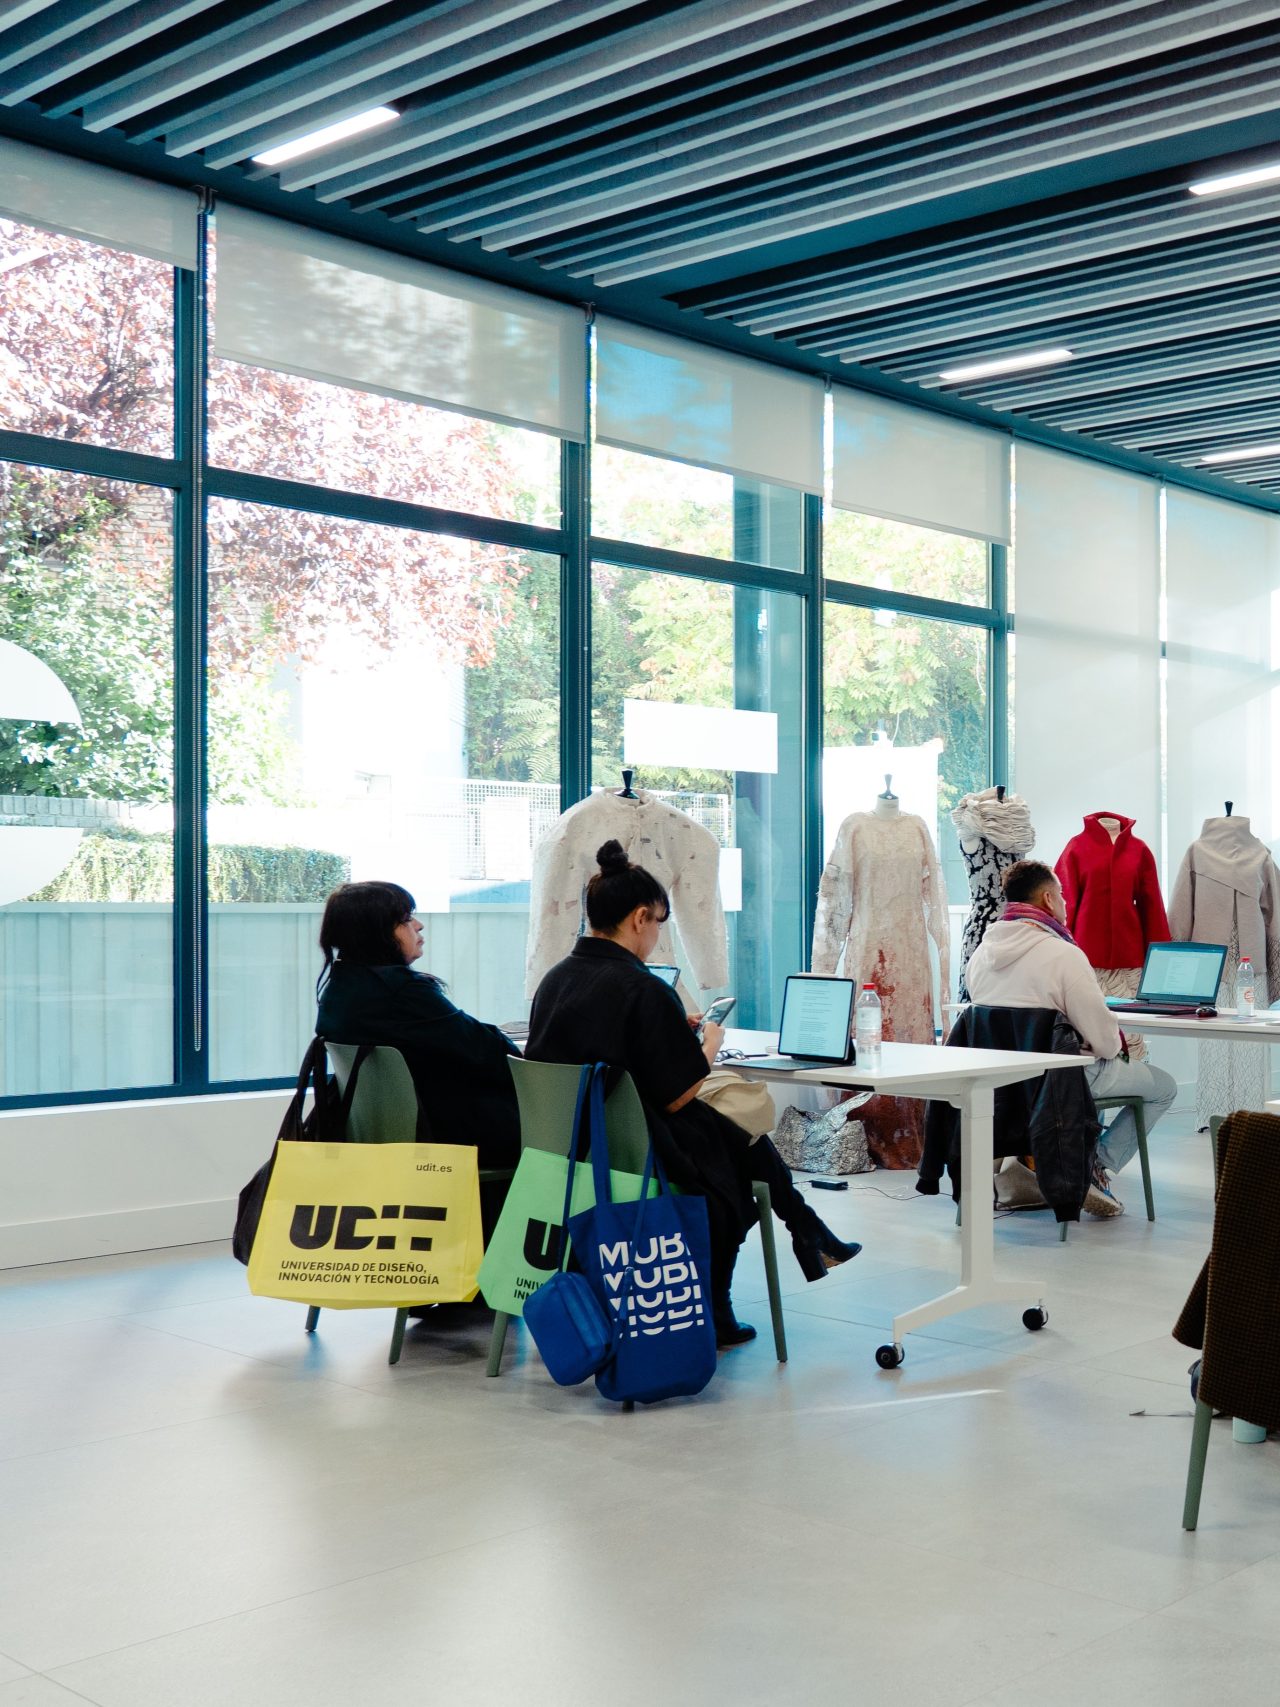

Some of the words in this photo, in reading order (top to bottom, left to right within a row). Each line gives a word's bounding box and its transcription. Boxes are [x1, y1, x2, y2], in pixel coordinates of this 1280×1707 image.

[416, 1163, 453, 1173] udit.es
[289, 1204, 448, 1251] UDIT
[281, 1260, 359, 1272] UNIVERSIDAD
[362, 1262, 376, 1272] DE
[378, 1261, 427, 1274] DISEÑO,
[278, 1271, 351, 1283] INNOVACIÓN
[354, 1274, 361, 1283] Y
[364, 1274, 439, 1285] TECNOLOGÍA
